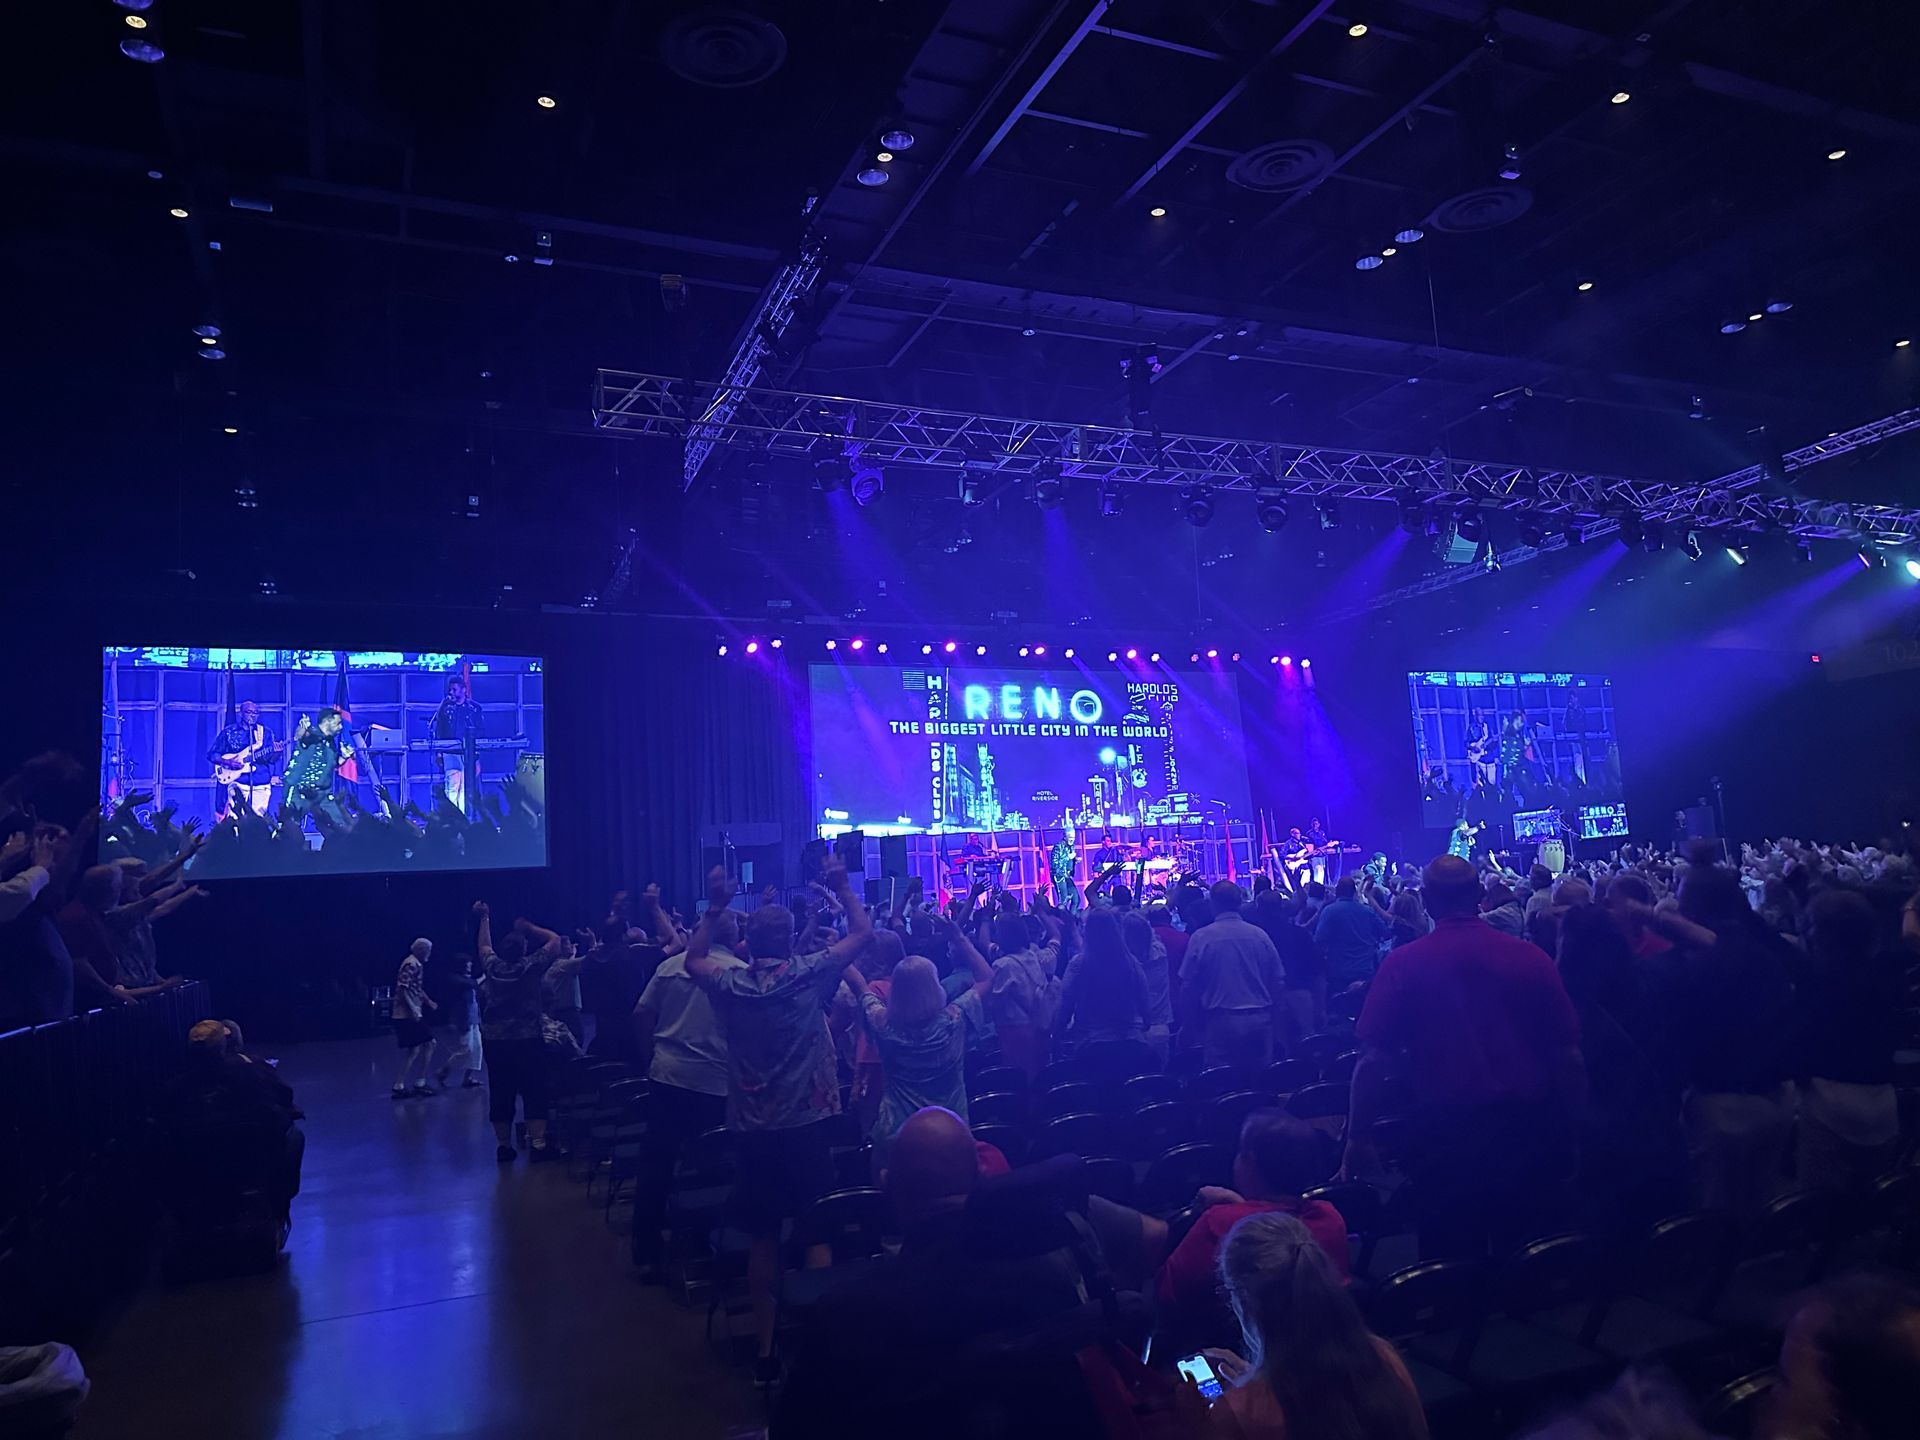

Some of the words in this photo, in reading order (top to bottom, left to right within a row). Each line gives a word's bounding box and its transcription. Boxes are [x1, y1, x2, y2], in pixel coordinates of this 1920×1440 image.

[964, 684, 1103, 723] RENO
[889, 721, 920, 734] THE
[924, 723, 985, 736] BIGGEST
[991, 724, 1036, 736] LITTLE
[1041, 724, 1071, 737] CITY
[1075, 725, 1089, 737] IN
[1093, 725, 1119, 737] THE
[1122, 726, 1168, 738] WORLD
